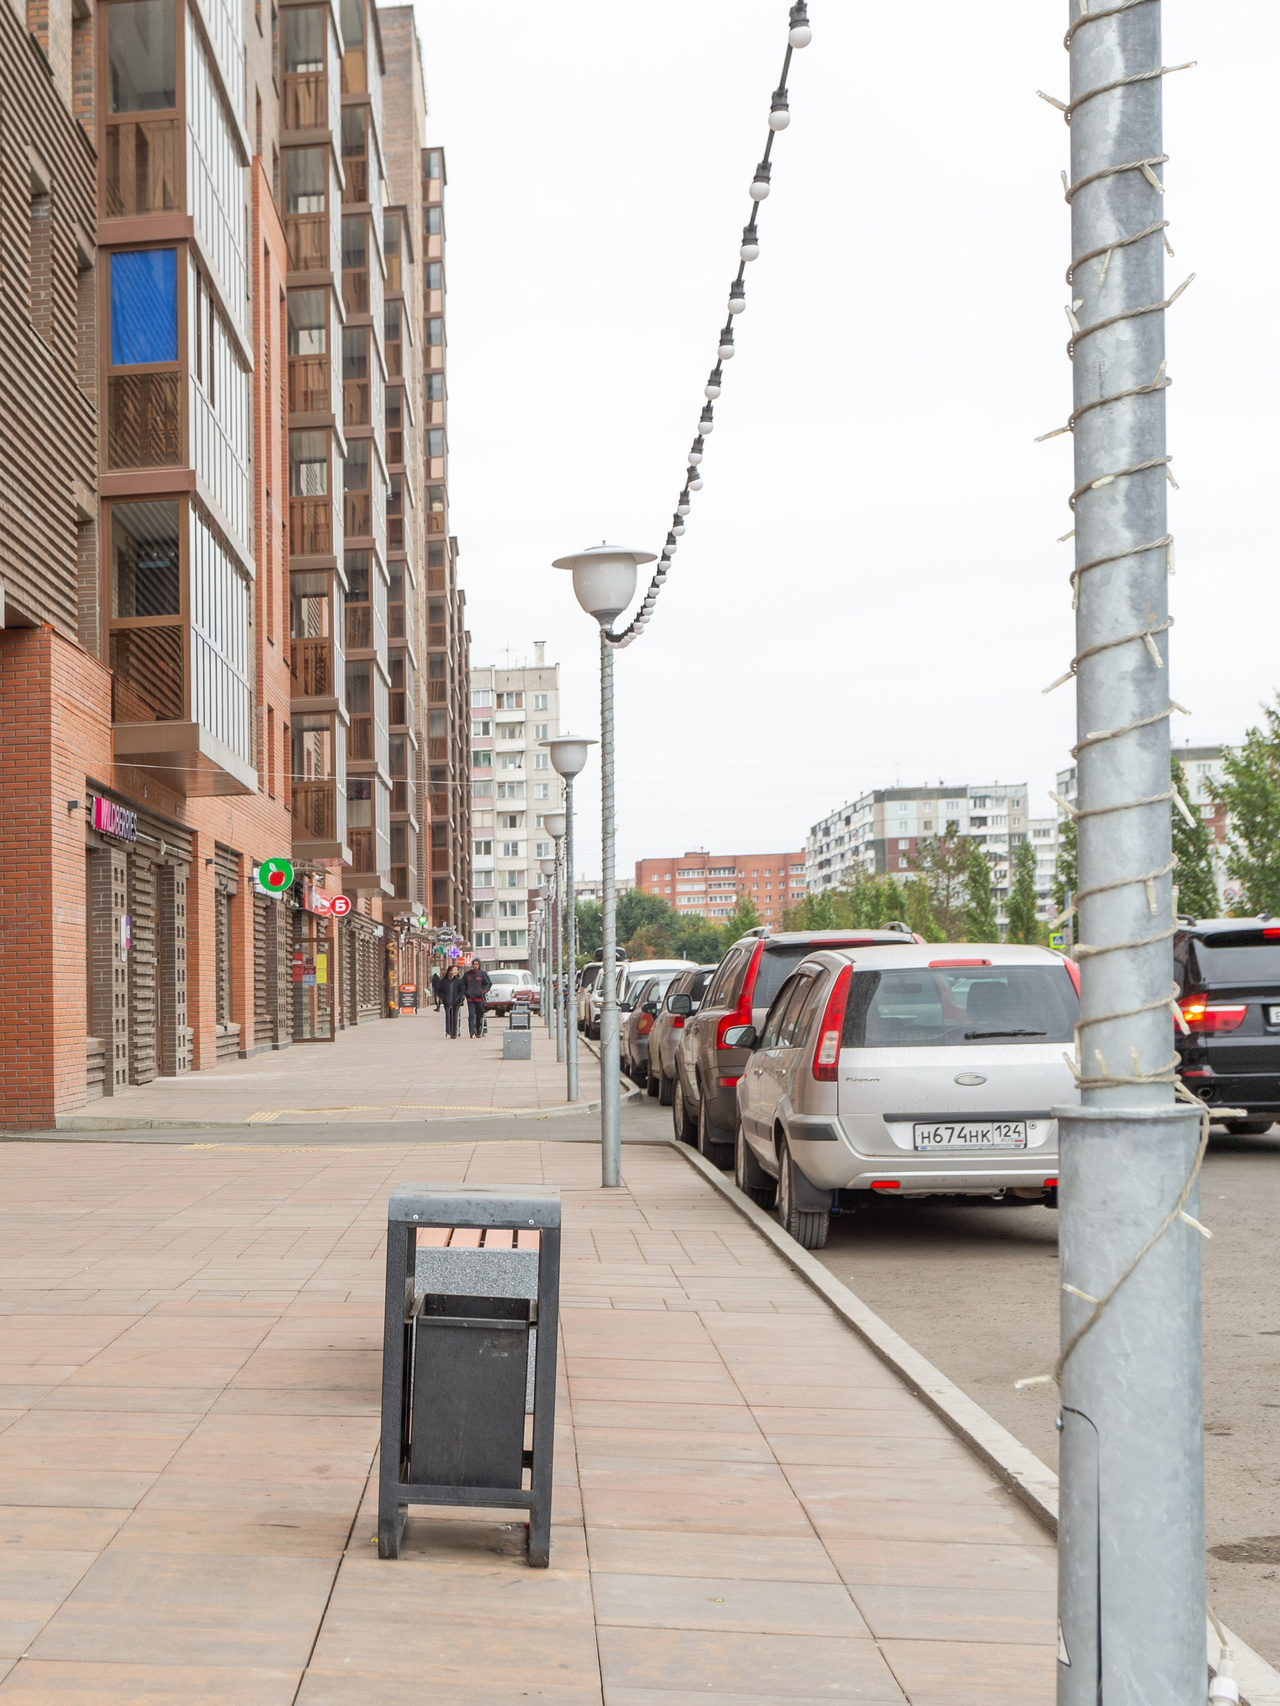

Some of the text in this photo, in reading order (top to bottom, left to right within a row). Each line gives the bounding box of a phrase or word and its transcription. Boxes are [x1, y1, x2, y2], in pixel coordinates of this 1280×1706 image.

[100, 797, 138, 842] WILDBERRIES
[334, 899, 347, 912] Б
[994, 1124, 1021, 1138] 124
